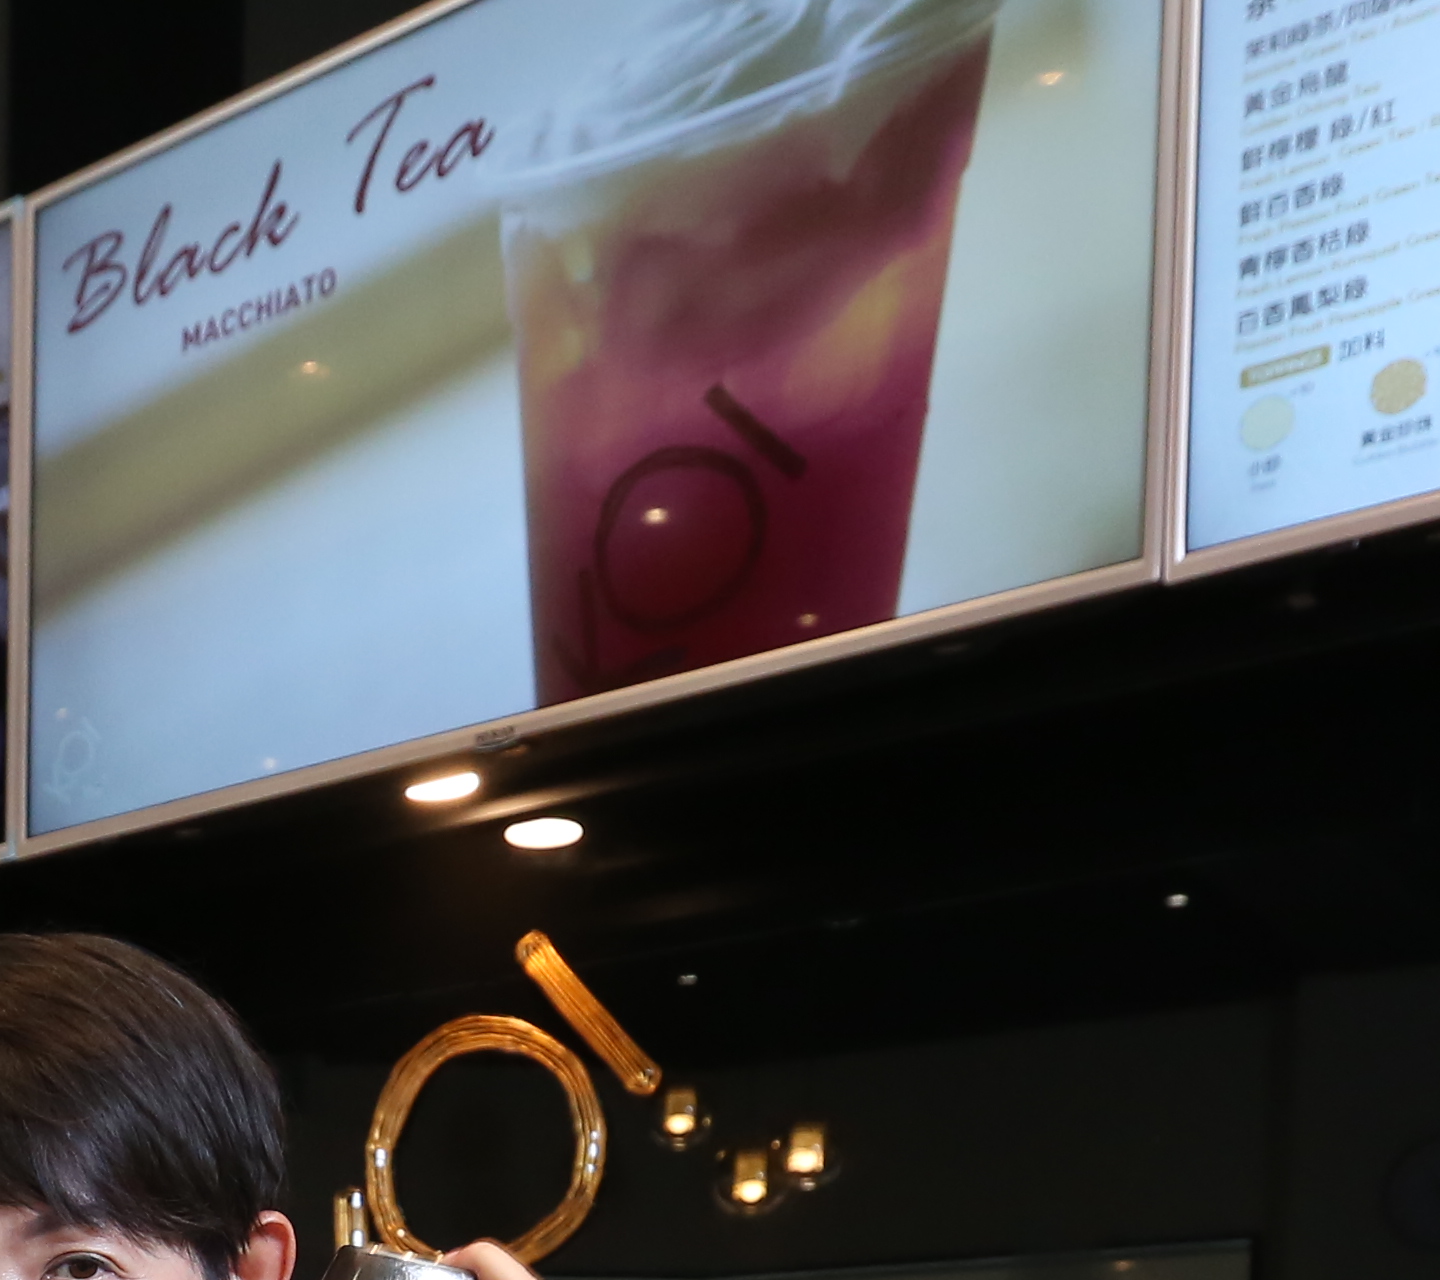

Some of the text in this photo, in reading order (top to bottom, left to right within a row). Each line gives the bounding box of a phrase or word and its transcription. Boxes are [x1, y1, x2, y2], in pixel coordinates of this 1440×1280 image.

[63, 74, 496, 335] Black Tea
[180, 266, 339, 353] MACCHIATO
